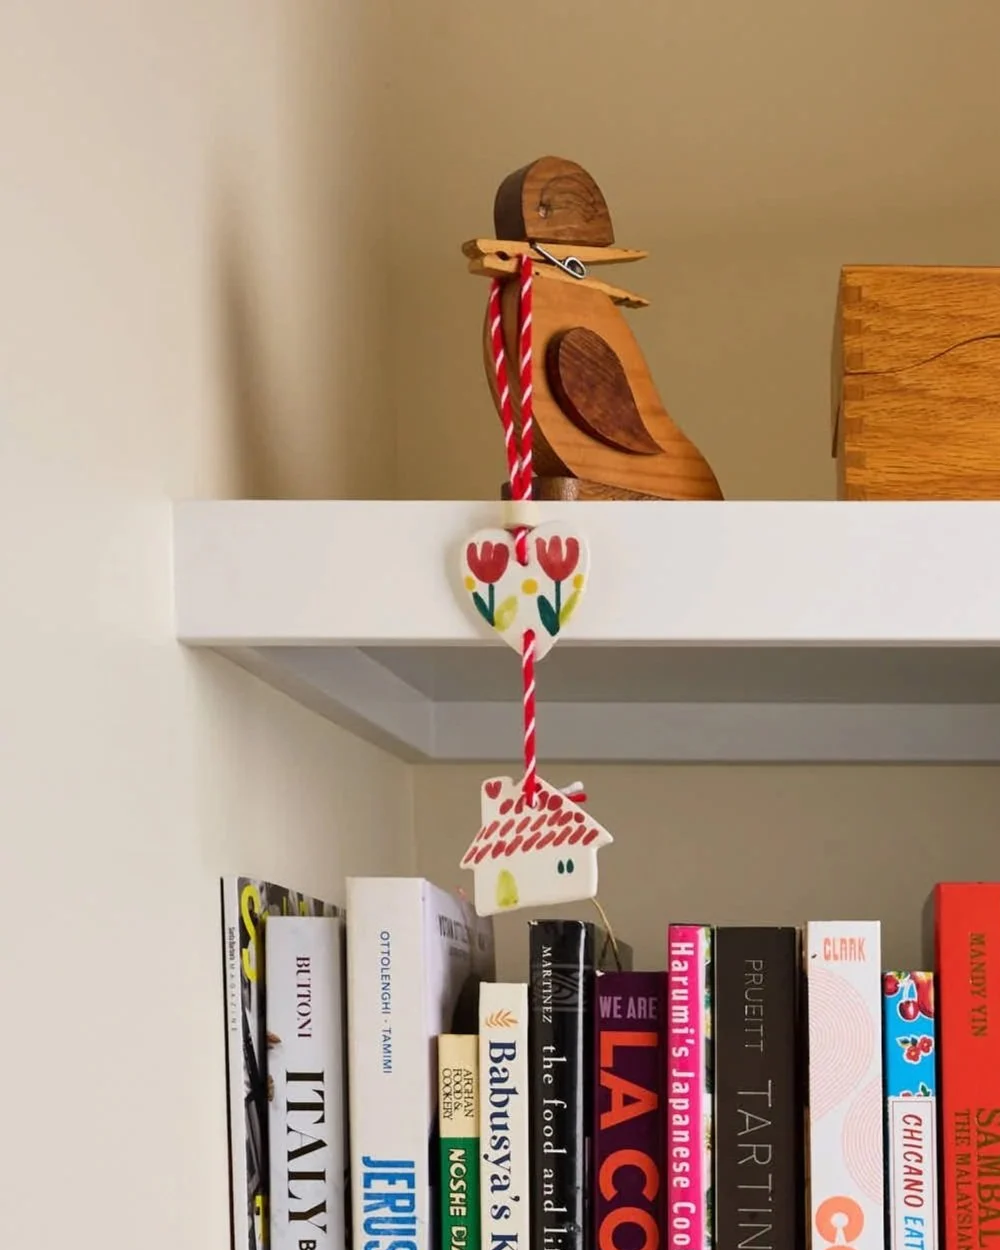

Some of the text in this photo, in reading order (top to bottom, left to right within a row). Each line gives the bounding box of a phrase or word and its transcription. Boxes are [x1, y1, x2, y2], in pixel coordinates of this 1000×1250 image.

[296, 956, 312, 1039] BUITONI
[380, 931, 392, 1074] OTTOLENGHI TAMIMI
[542, 946, 553, 1024] MARTINEZ
[600, 996, 658, 1019] WE ARE
[671, 942, 695, 1057] Harumi's
[745, 959, 763, 1053] PRUEITT
[542, 1045, 567, 1084] the
[599, 1030, 659, 1131] LA
[285, 1069, 328, 1233] ITALY
[484, 1040, 520, 1221] Babusya's
[542, 1098, 567, 1154] food
[669, 1068, 697, 1188] Japanese
[902, 1114, 924, 1207] CHICANO
[955, 1110, 971, 1147] THE
[448, 1147, 466, 1216] NOSHE
[542, 1168, 567, 1213] and
